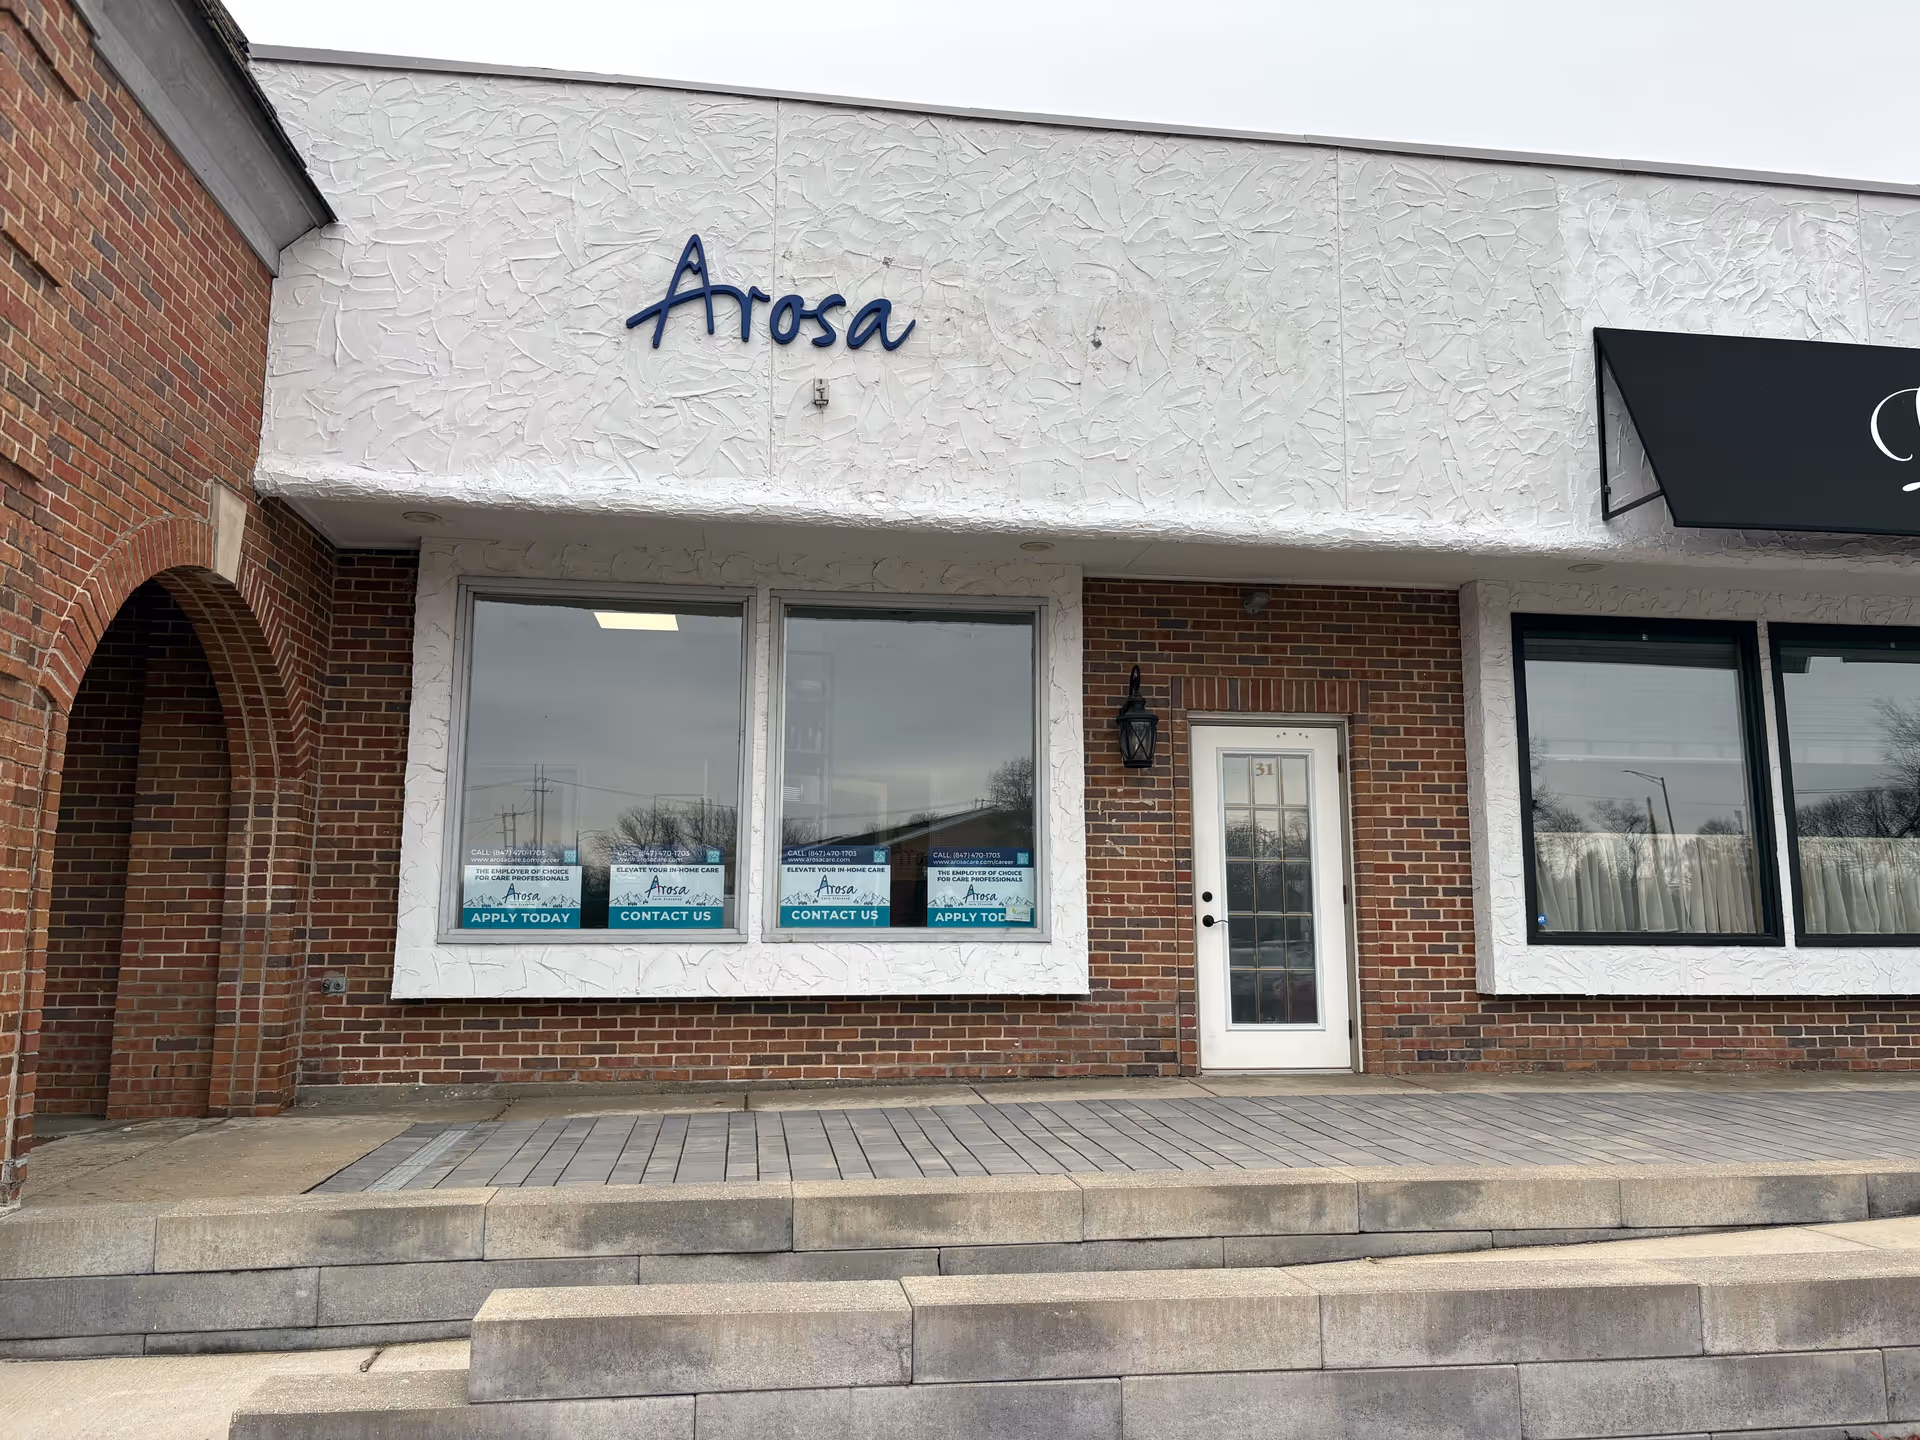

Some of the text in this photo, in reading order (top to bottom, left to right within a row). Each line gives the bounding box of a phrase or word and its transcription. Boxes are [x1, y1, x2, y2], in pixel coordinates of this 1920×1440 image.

[626, 234, 916, 350] Arosa
[1255, 762, 1274, 776] 31
[502, 883, 541, 904] Arosa
[645, 875, 691, 898] Arosa
[814, 874, 858, 898] Arosa
[962, 884, 998, 904] Arosa
[471, 913, 570, 923] APPLY TODAY
[620, 911, 711, 921] CONTACT US
[791, 910, 879, 920] CONTACT US
[935, 912, 977, 922] APPLY
[981, 912, 1006, 922] TOD
